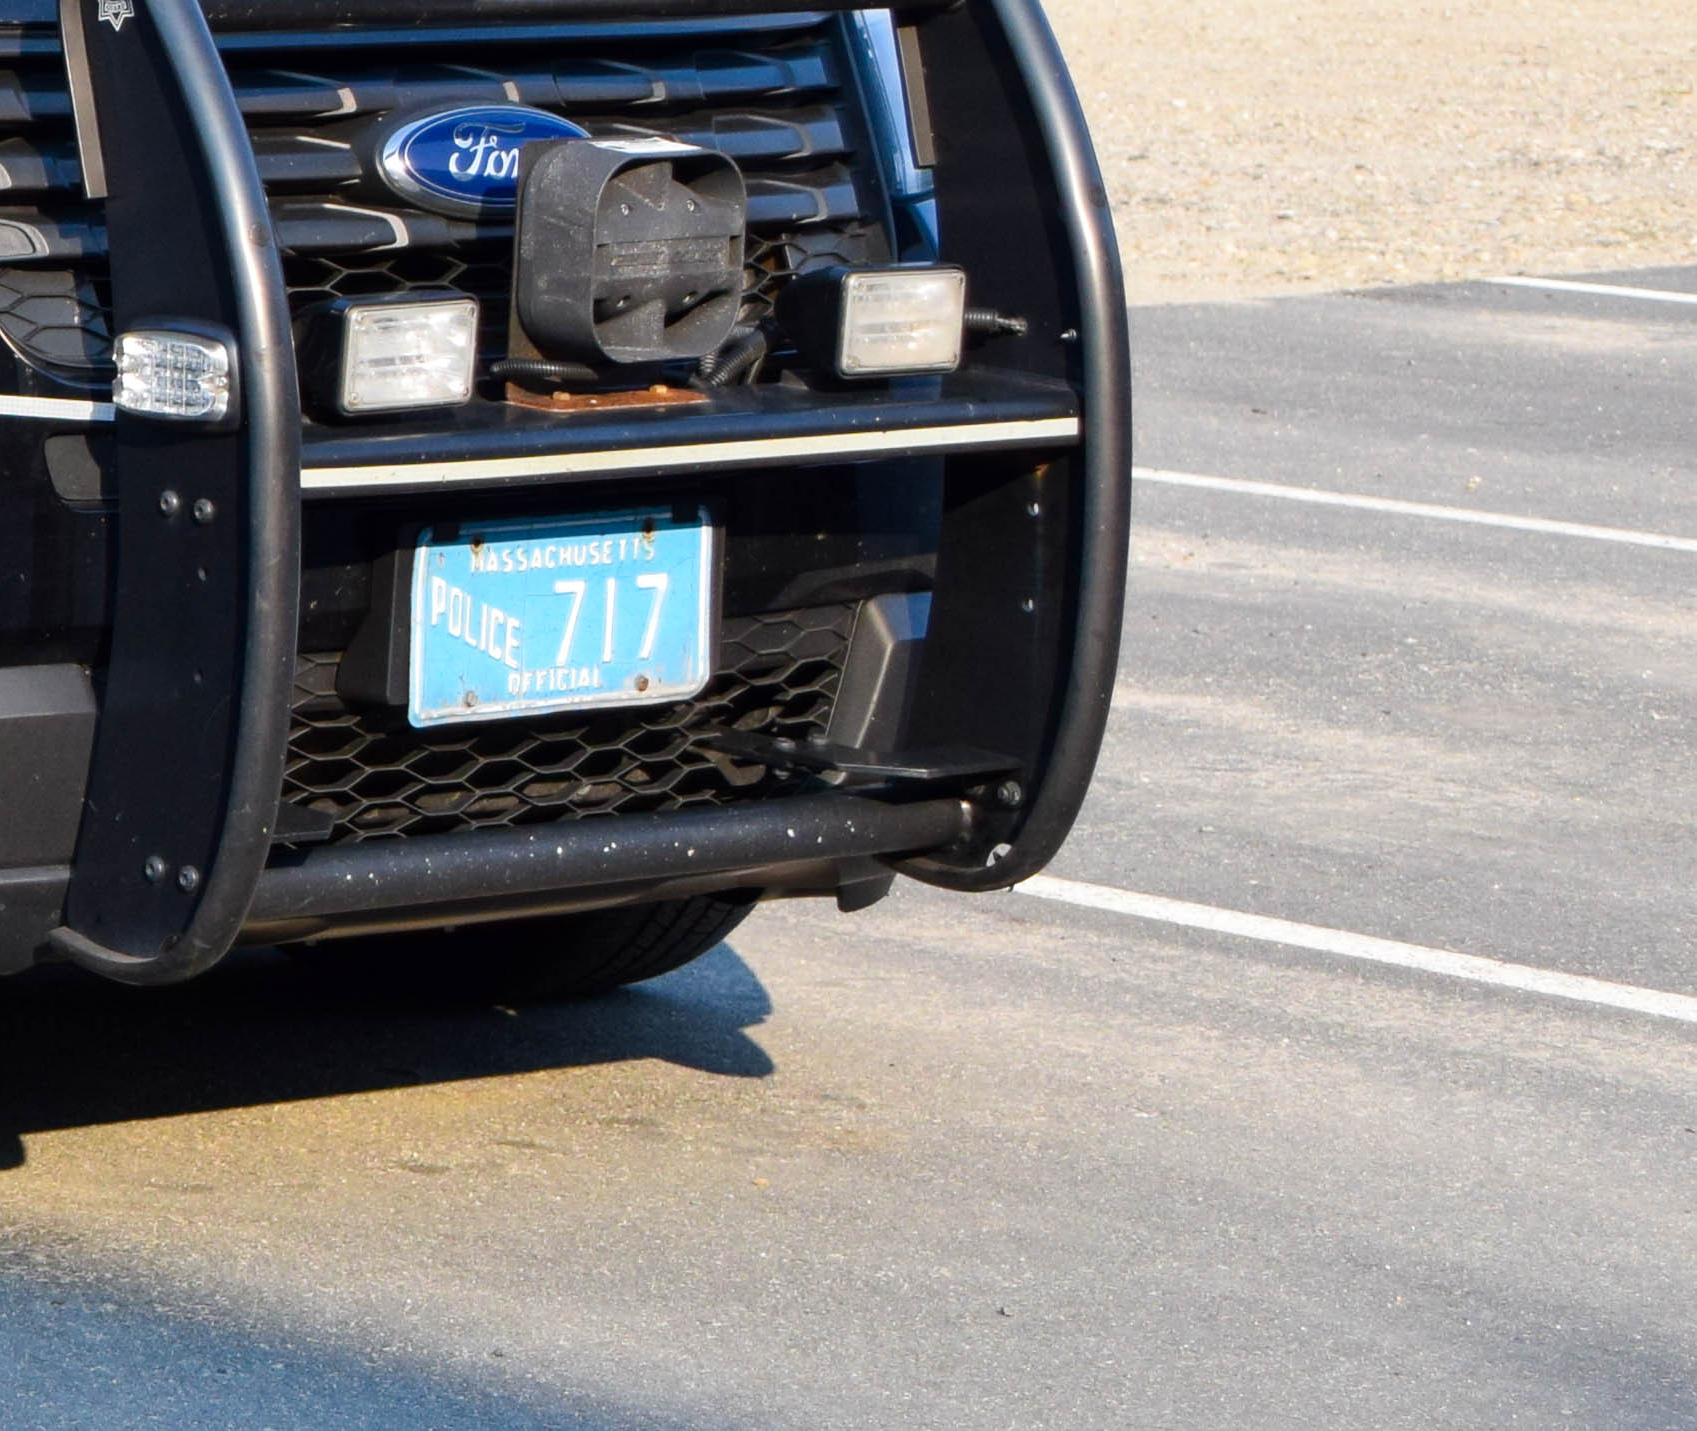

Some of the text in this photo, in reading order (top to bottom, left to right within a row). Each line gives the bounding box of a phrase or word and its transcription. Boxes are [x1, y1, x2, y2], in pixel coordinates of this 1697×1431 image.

[449, 121, 520, 182] For
[470, 538, 656, 573] MASSACHUSETTS
[430, 572, 669, 670] POLICE 717
[508, 666, 603, 696] OFFICIAL
